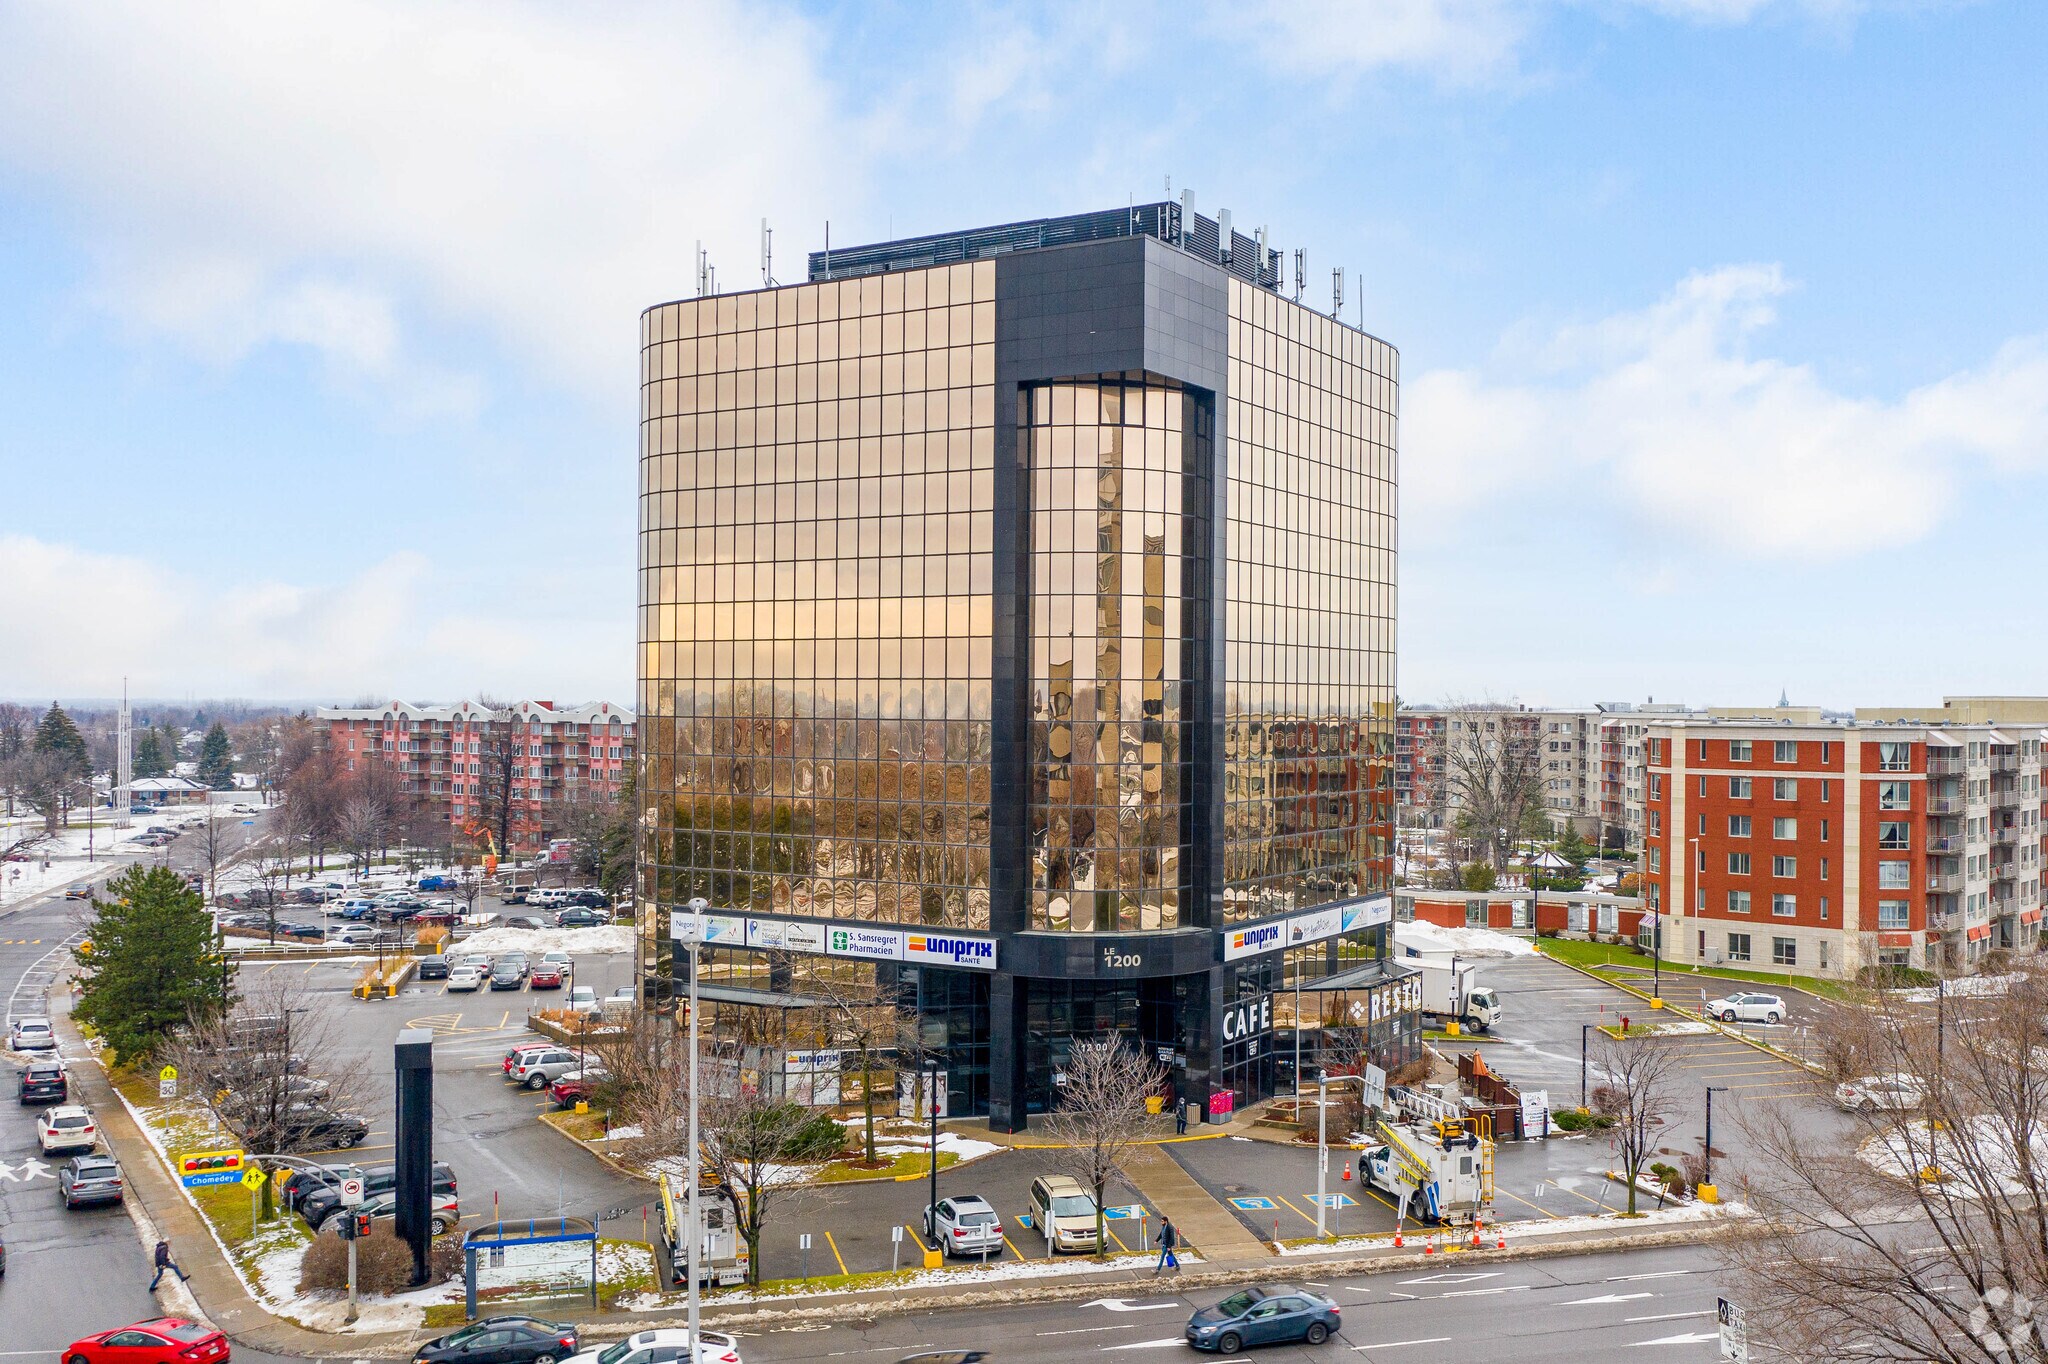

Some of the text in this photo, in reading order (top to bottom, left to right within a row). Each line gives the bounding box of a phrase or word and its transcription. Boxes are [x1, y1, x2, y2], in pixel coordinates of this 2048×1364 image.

[849, 932, 898, 945] S. Sansregret
[1244, 925, 1279, 949] uniprix
[849, 944, 893, 955] Pharmacien
[926, 937, 992, 962] uniprix
[1104, 947, 1115, 955] LE
[960, 956, 981, 965] SANTÉ
[1104, 954, 1141, 968] 1200
[1371, 980, 1422, 1021] RESTO
[1223, 996, 1270, 1040] CAFÉ
[1081, 1043, 1108, 1052] 1200
[162, 1085, 175, 1095] 30
[192, 1175, 234, 1185] Chomedey
[1729, 1306, 1745, 1320] BUS
[1730, 1318, 1746, 1332] TAXI
